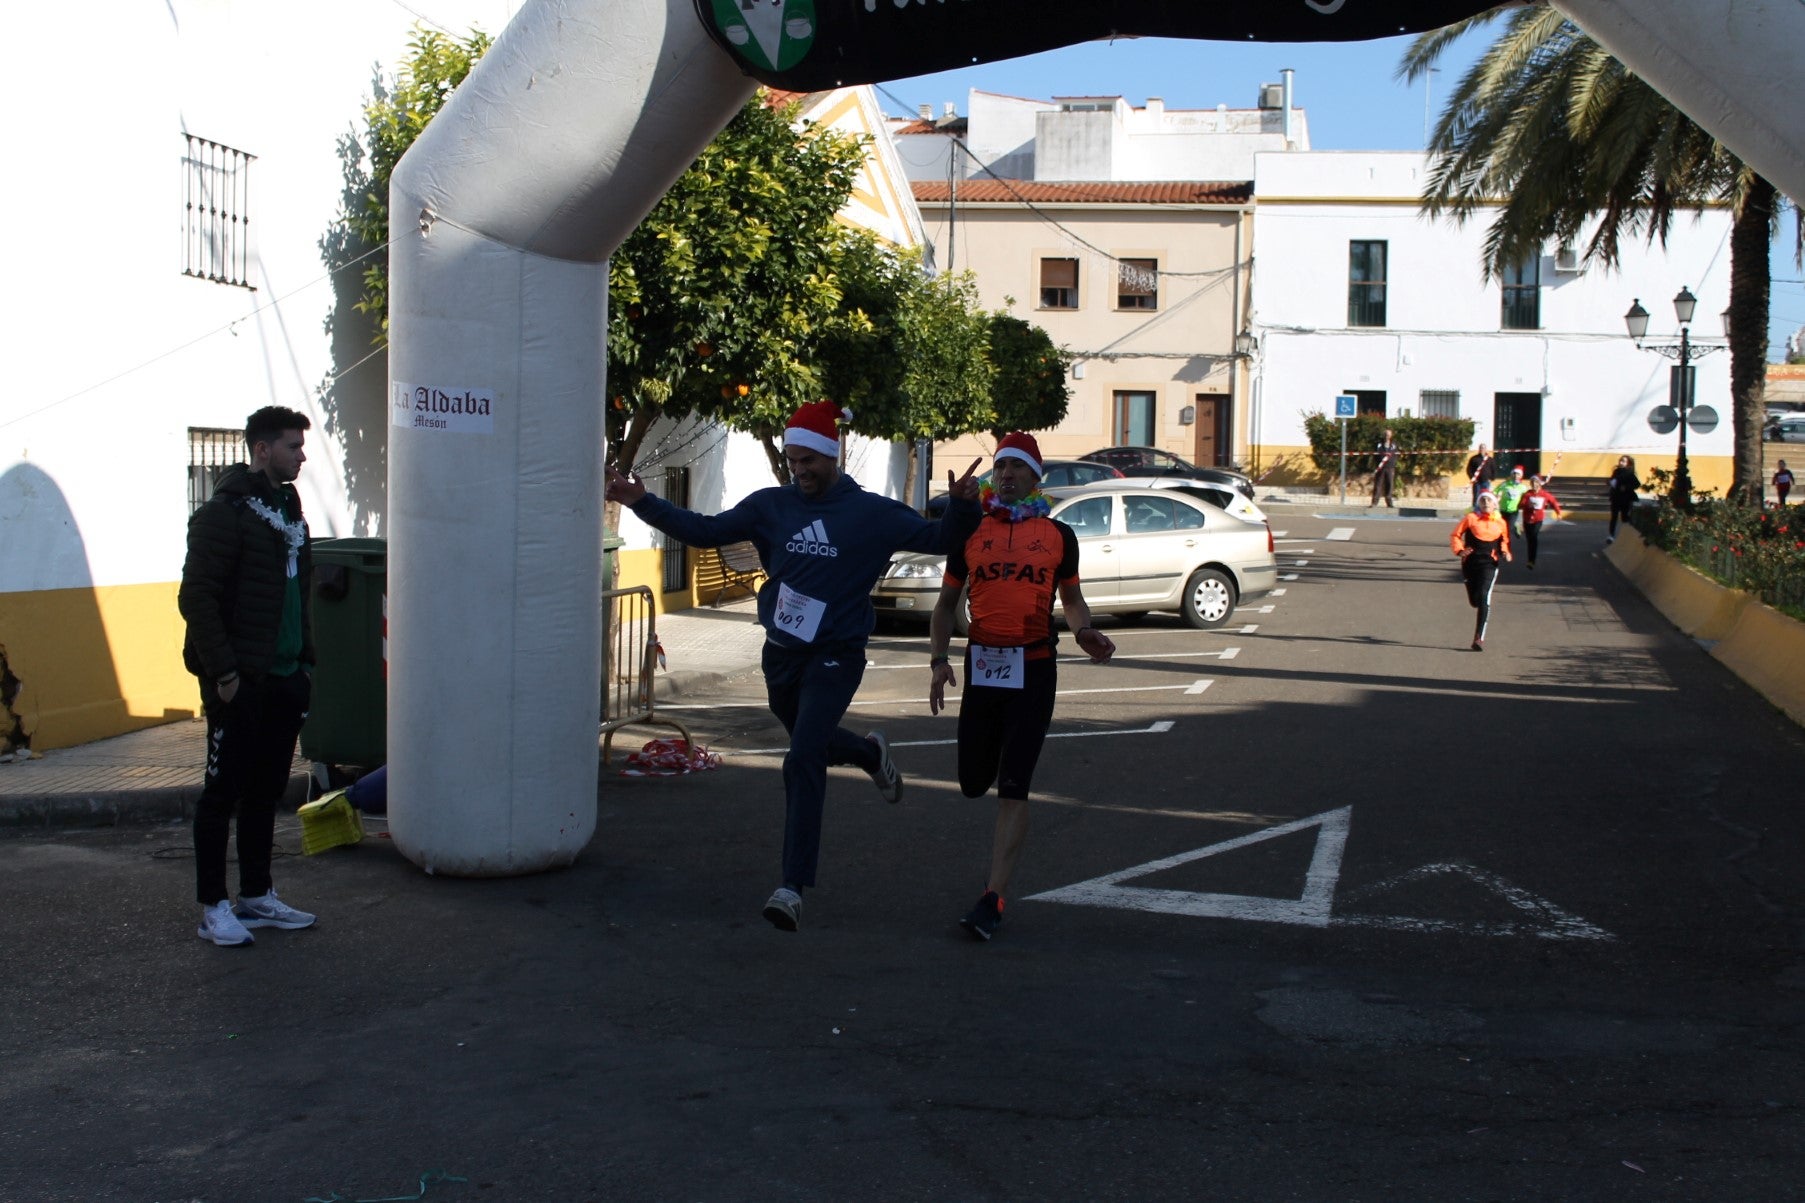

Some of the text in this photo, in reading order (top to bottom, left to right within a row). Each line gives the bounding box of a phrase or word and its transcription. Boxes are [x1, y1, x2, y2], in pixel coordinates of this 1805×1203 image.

[393, 383, 491, 415] La Aldaba
[414, 415, 447, 428] Mesón
[785, 540, 838, 557] adidas
[974, 562, 1048, 585] ASFAS
[778, 611, 804, 629] 009
[985, 665, 1011, 680] 012
